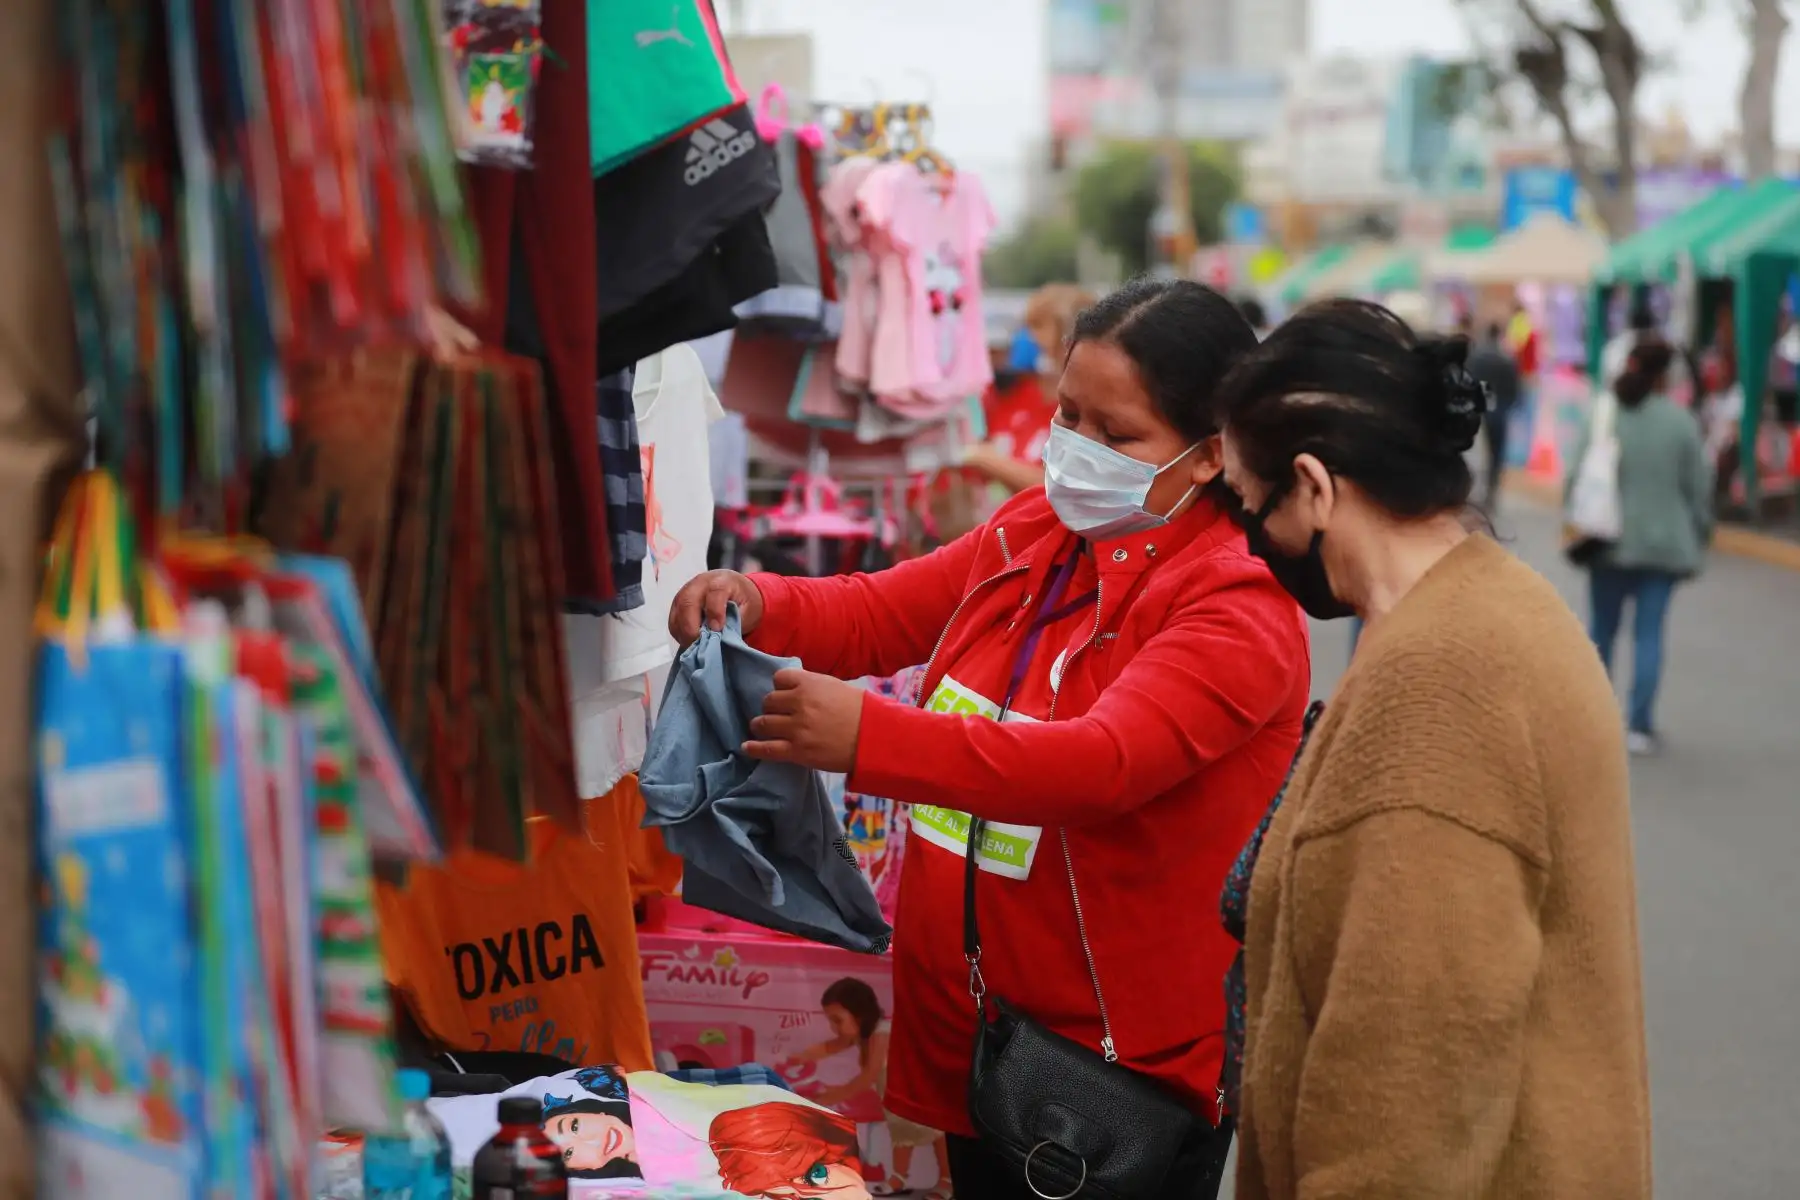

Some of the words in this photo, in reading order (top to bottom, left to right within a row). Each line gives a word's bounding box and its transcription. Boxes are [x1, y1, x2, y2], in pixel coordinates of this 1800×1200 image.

[684, 130, 756, 187] adidas
[445, 914, 605, 1000] OXICA
[489, 996, 539, 1025] PERO
